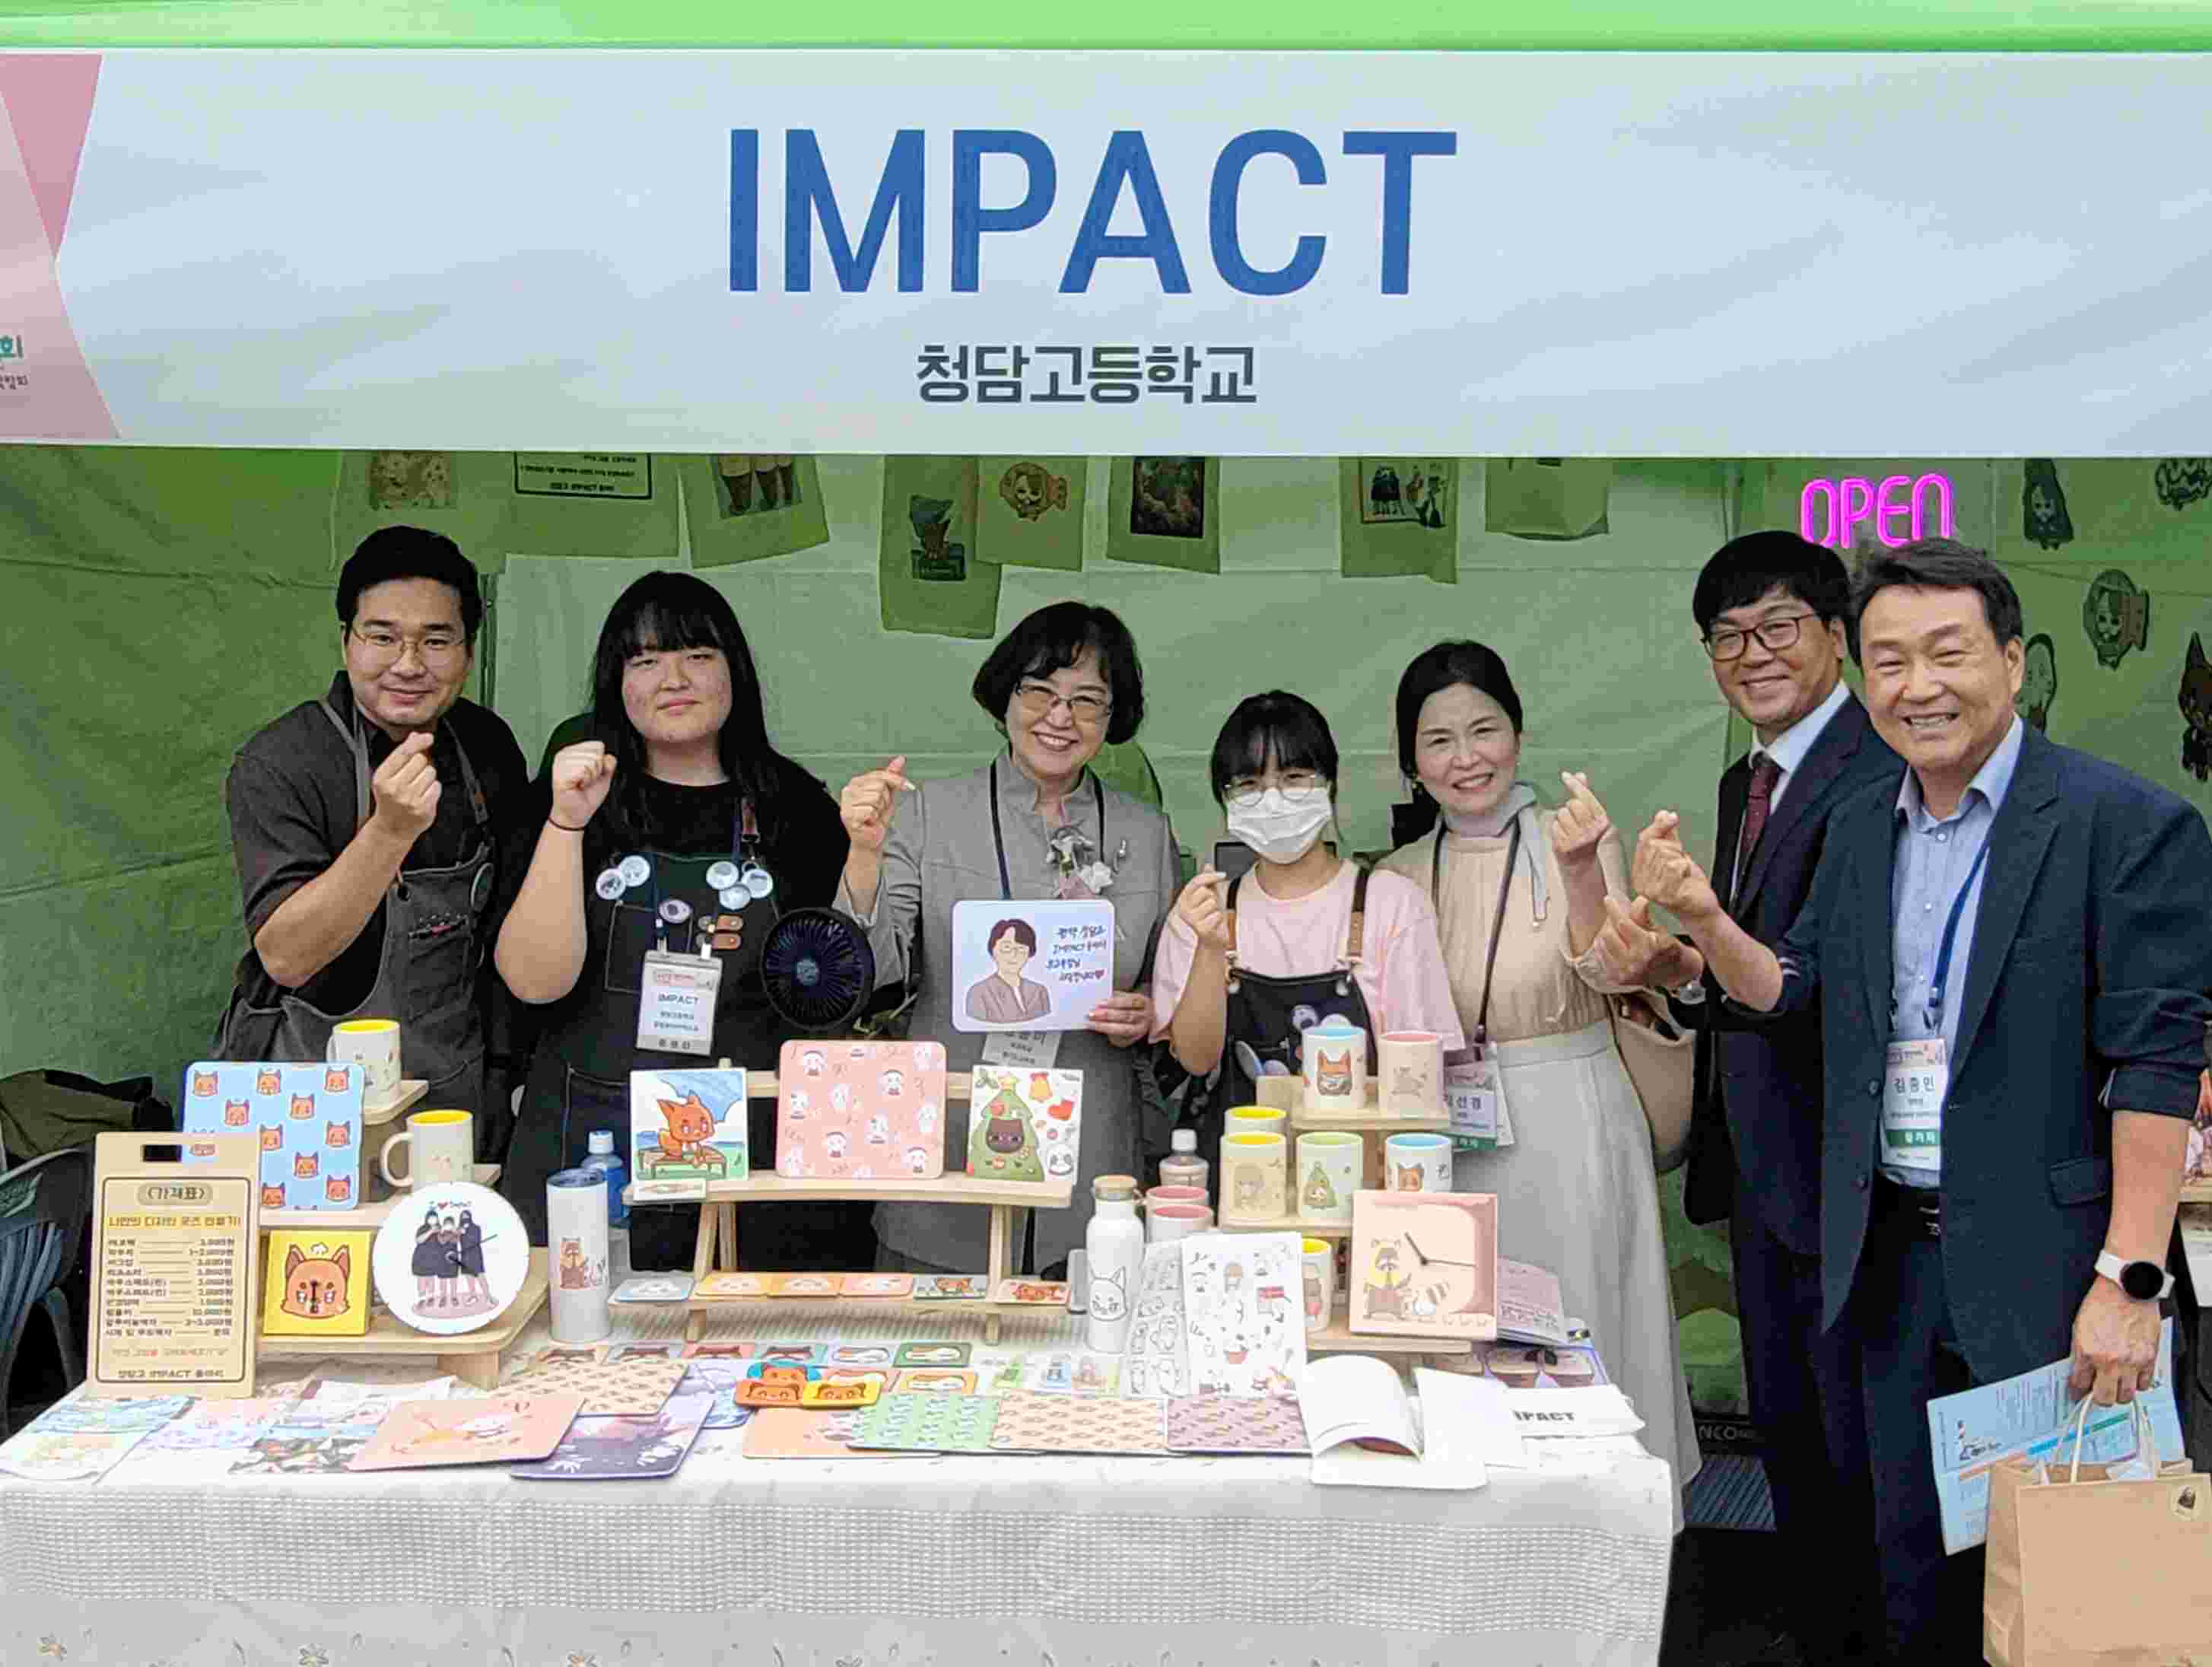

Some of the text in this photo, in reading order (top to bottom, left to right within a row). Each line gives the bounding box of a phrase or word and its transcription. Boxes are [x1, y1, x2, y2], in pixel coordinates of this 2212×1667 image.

[729, 129, 1457, 296] IMPACT
[917, 344, 1257, 403] 청담고등학교
[1801, 475, 1953, 549] OPEN
[658, 994, 699, 1004] IMPACT
